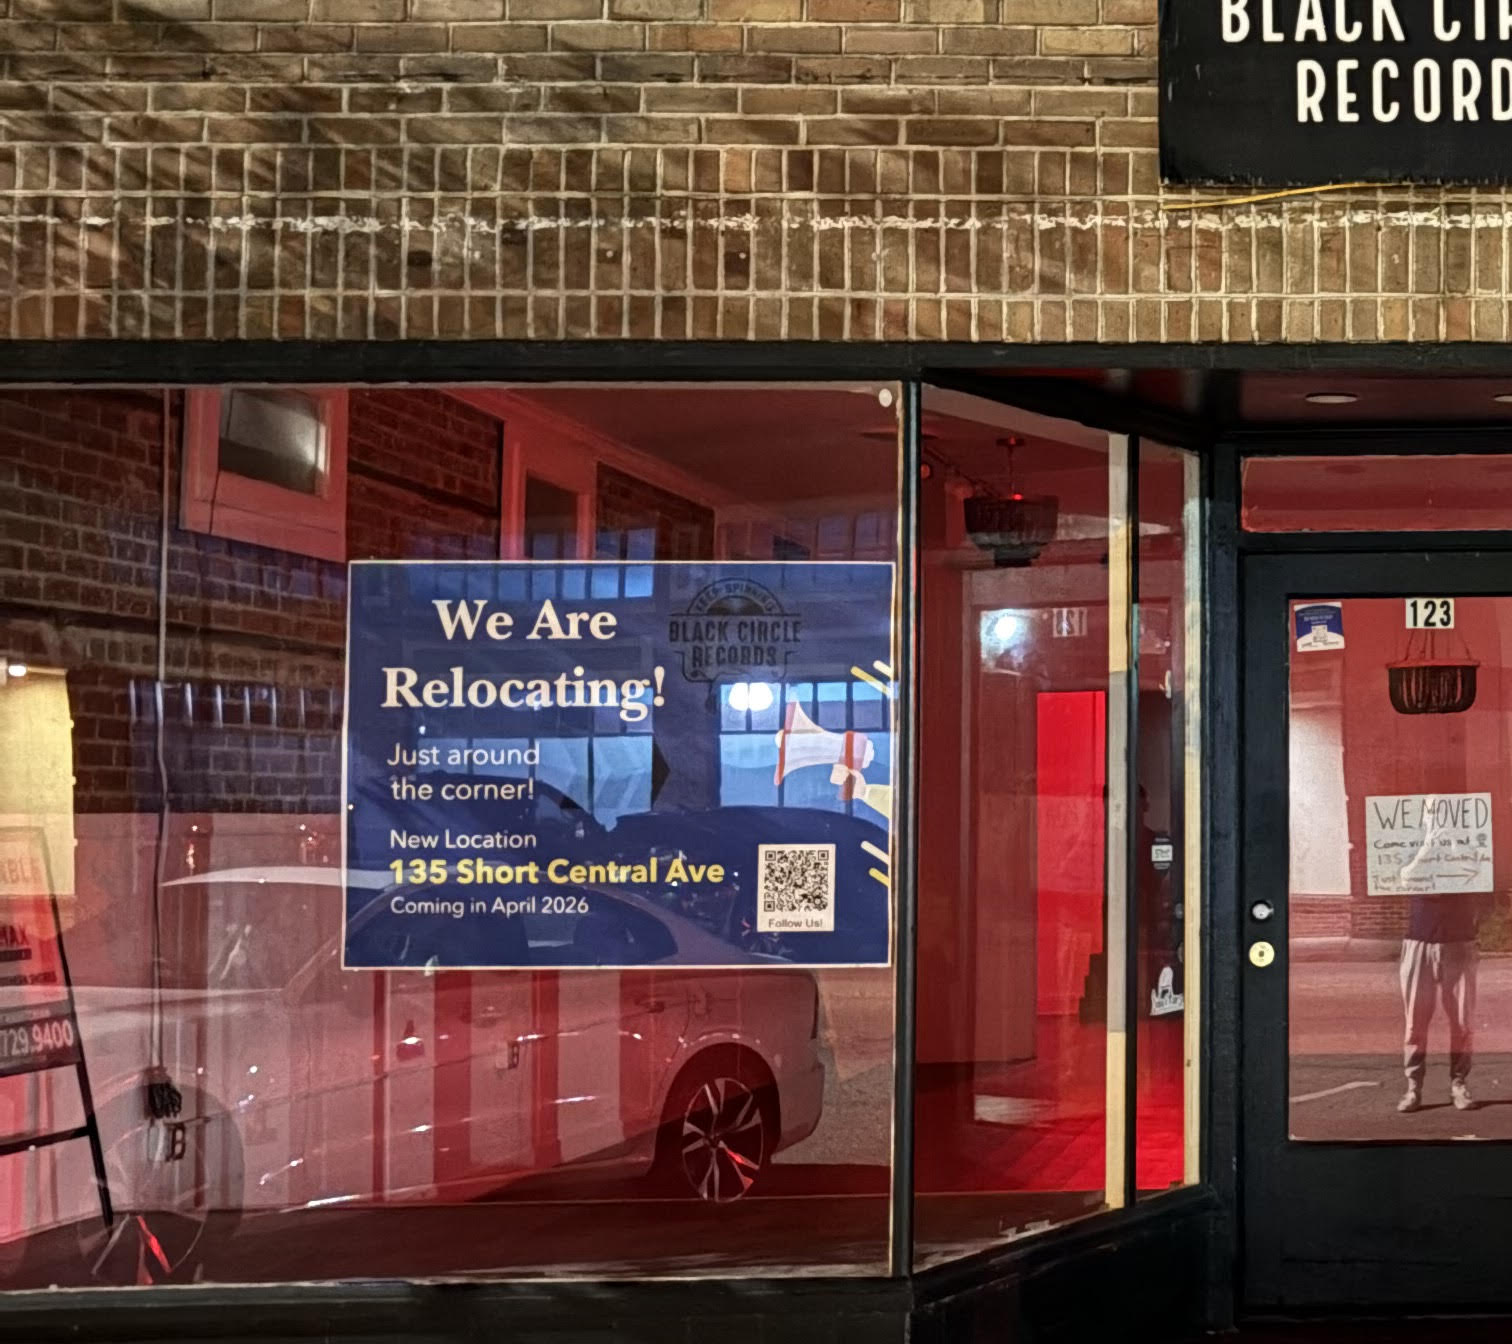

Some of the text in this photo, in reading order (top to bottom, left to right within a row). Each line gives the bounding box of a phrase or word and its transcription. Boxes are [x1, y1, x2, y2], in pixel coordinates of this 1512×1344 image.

[432, 600, 618, 640] We Are
[1410, 600, 1453, 627] 123
[668, 621, 801, 643] BLACK CIRCLE
[692, 646, 777, 667] RECORDS
[382, 666, 666, 722] Relocating!
[387, 741, 540, 767] Just around
[391, 778, 535, 802] the corner!
[1373, 797, 1489, 830] WE MOVED
[390, 830, 537, 850] New Location
[390, 858, 725, 884] 135 Short Central Ave
[391, 897, 589, 919] Coming in April 2026
[768, 918, 823, 928] Follow Us!
